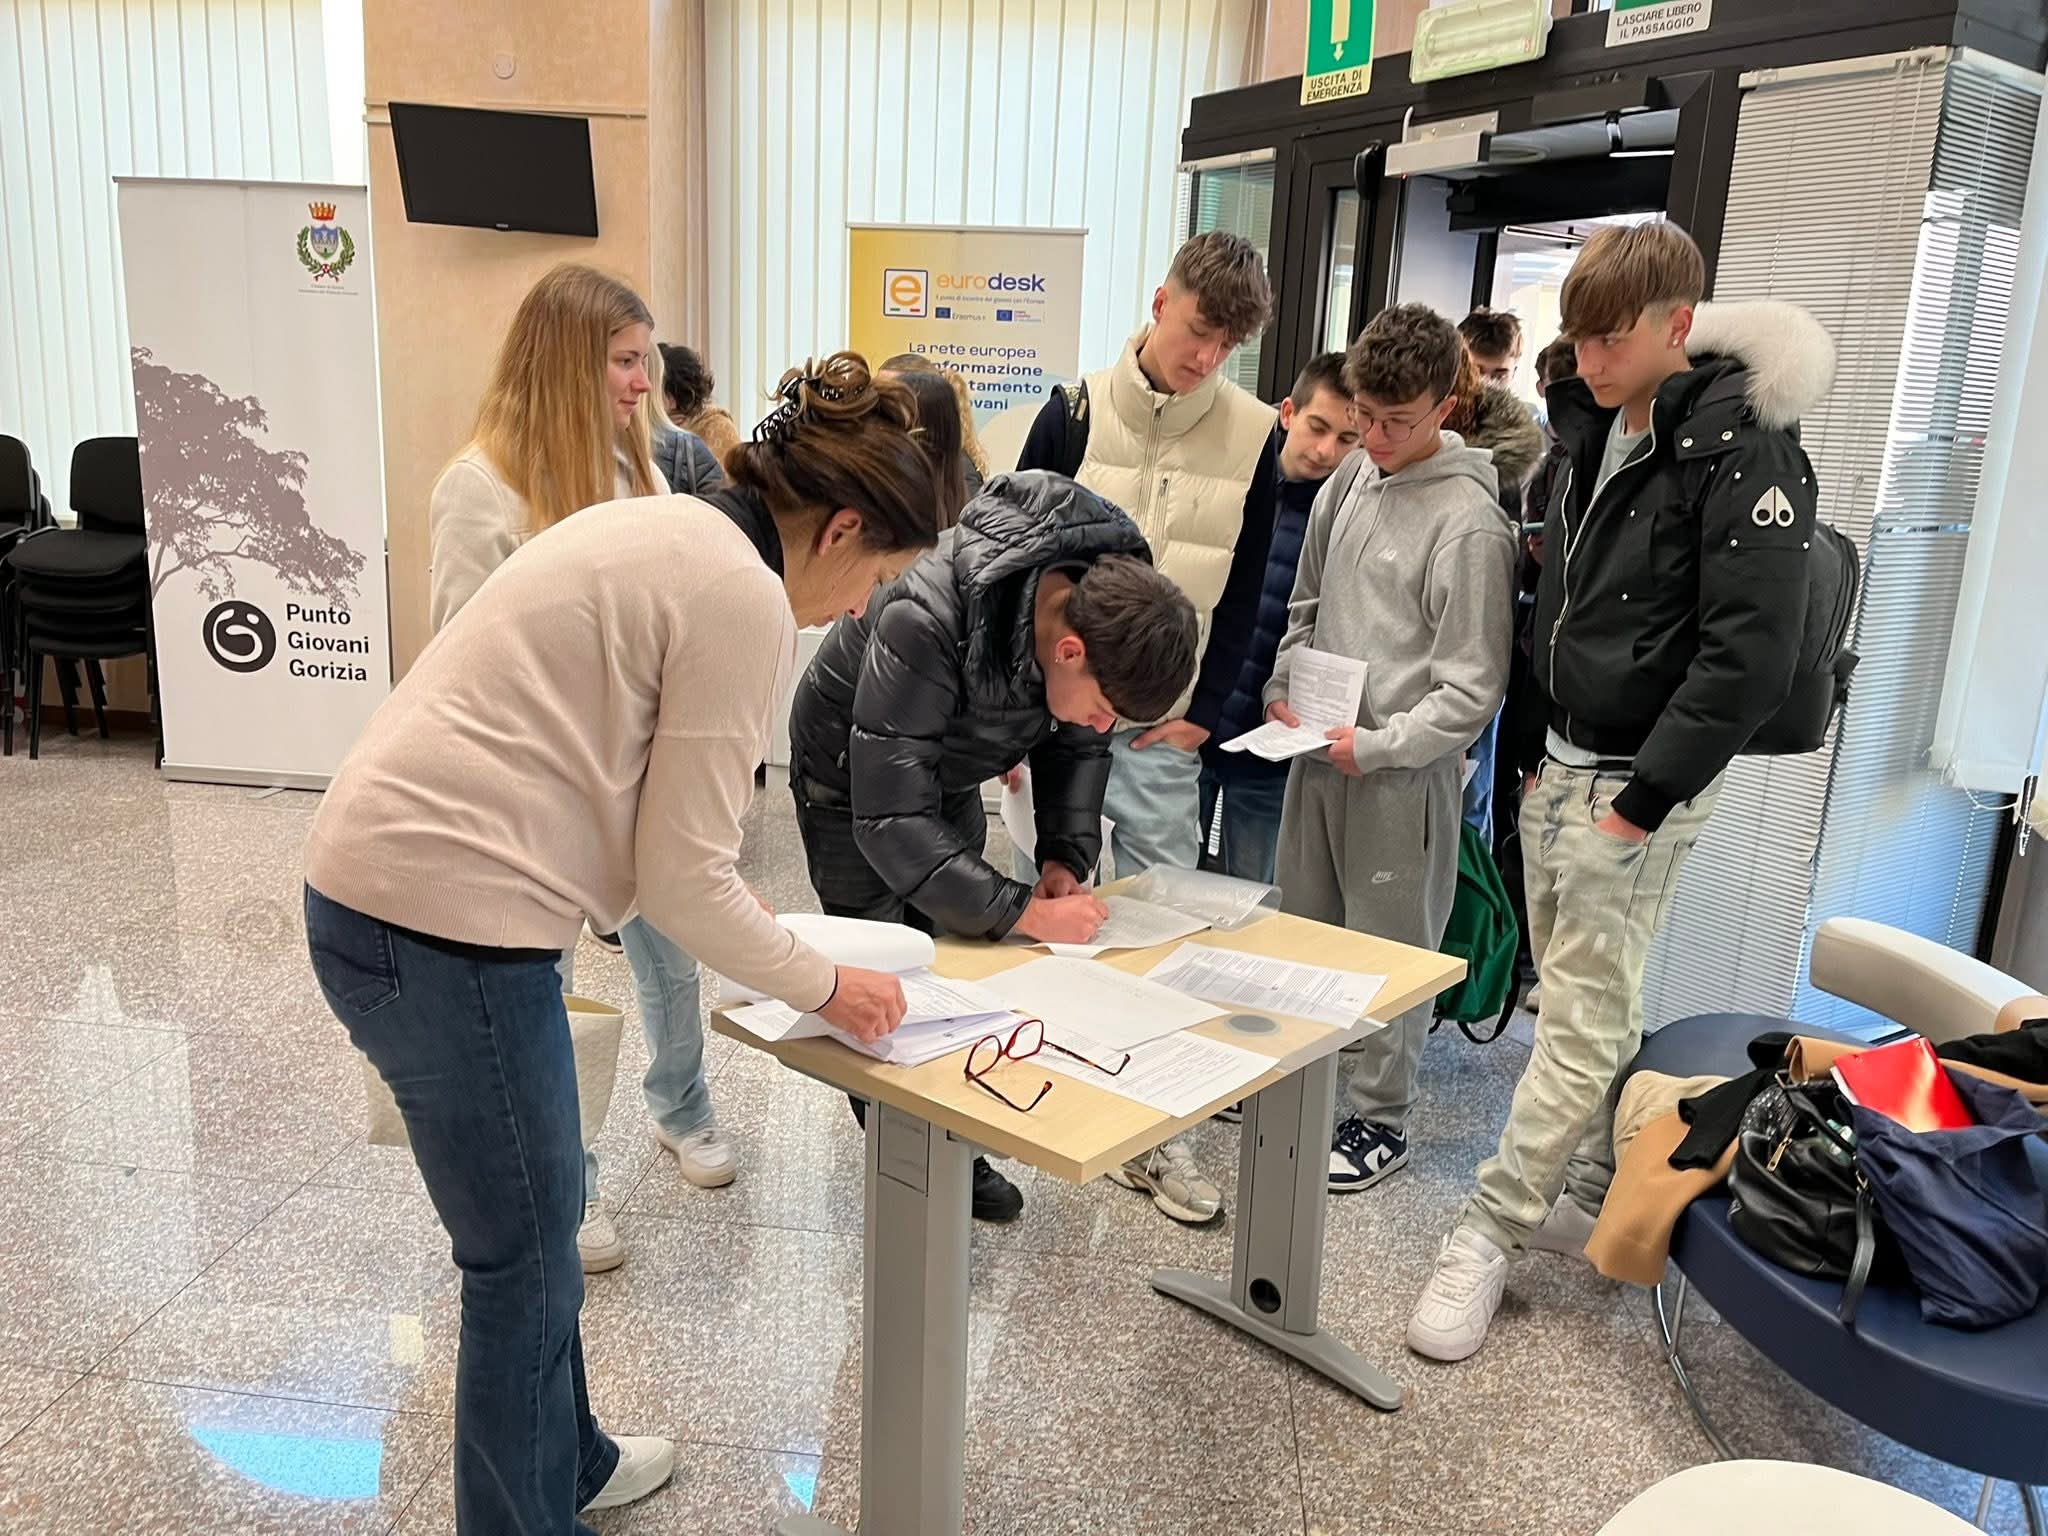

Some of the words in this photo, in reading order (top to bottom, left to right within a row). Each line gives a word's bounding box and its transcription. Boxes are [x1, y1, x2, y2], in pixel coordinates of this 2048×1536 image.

[1617, 9, 1664, 27] LASCIARE
[1666, 2, 1702, 18] LIBERO
[1619, 29, 1629, 39] IL
[1632, 17, 1694, 38] PASSAGGIO
[1311, 72, 1346, 89] USCITA
[1352, 69, 1362, 81] DI
[1307, 81, 1362, 101] EMERGENZA
[936, 273, 1046, 293] eurodesk
[909, 342, 926, 353] La
[930, 344, 966, 355] rete
[969, 346, 1036, 360] europea
[933, 360, 1043, 377] nformazione
[968, 380, 1042, 394] tamento
[970, 399, 1008, 410] vani
[286, 603, 351, 625] Punto
[287, 631, 370, 654] Giovani
[289, 659, 368, 681] Gorizia
